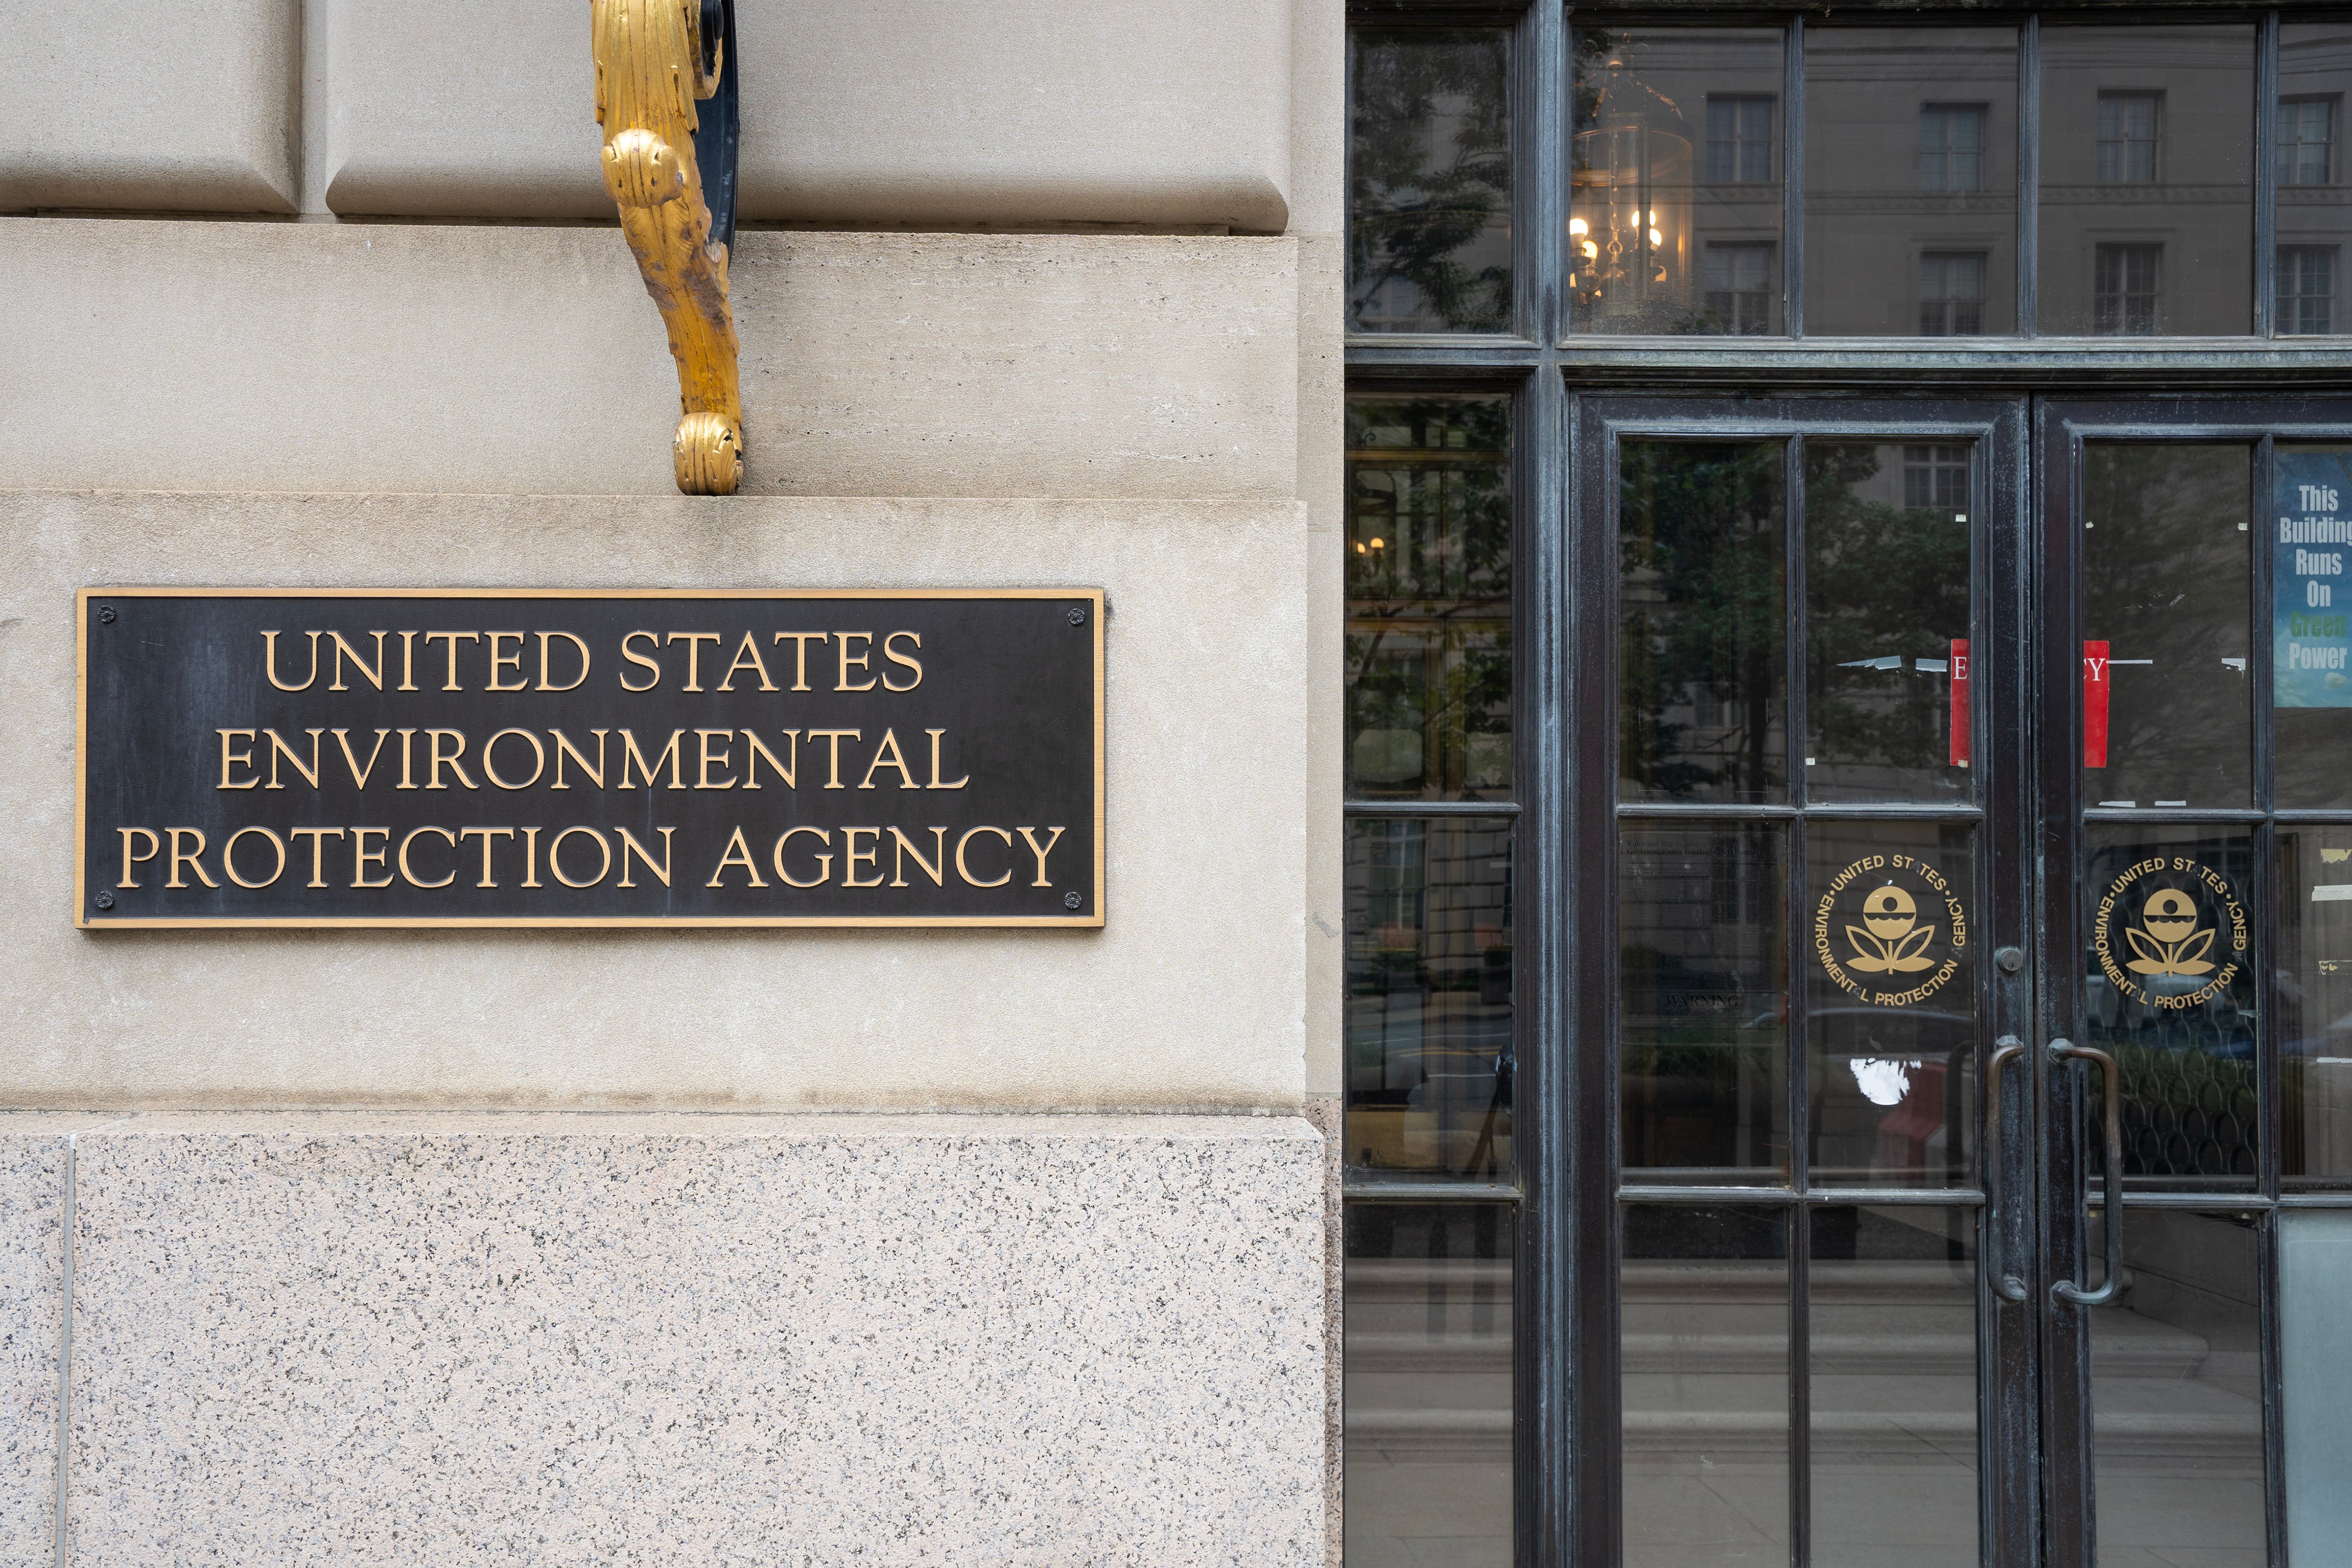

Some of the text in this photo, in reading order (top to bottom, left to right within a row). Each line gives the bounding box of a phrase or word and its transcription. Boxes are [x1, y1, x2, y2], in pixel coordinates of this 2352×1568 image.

[2299, 485, 2339, 512] This
[2296, 549, 2343, 575] Runs
[2307, 580, 2331, 607] On
[2290, 611, 2346, 638] Green
[261, 631, 923, 692] UNITED STATES
[2289, 643, 2348, 670] Power
[216, 729, 969, 790] ENVIRONMENTAL
[117, 826, 1066, 888] PROTECTION AGENCY
[1831, 855, 1946, 891] UNITED STTES
[2111, 857, 2228, 894] UNITED STTES
[1815, 894, 1869, 1002] ENVIRONMENTL
[1874, 958, 1958, 1006] PROTECTION
[1945, 897, 1966, 957] GENCY
[2095, 896, 2247, 1009] ENVIRONMENTL PROTECTION GENCY
[1665, 994, 1740, 1006] WARNING
